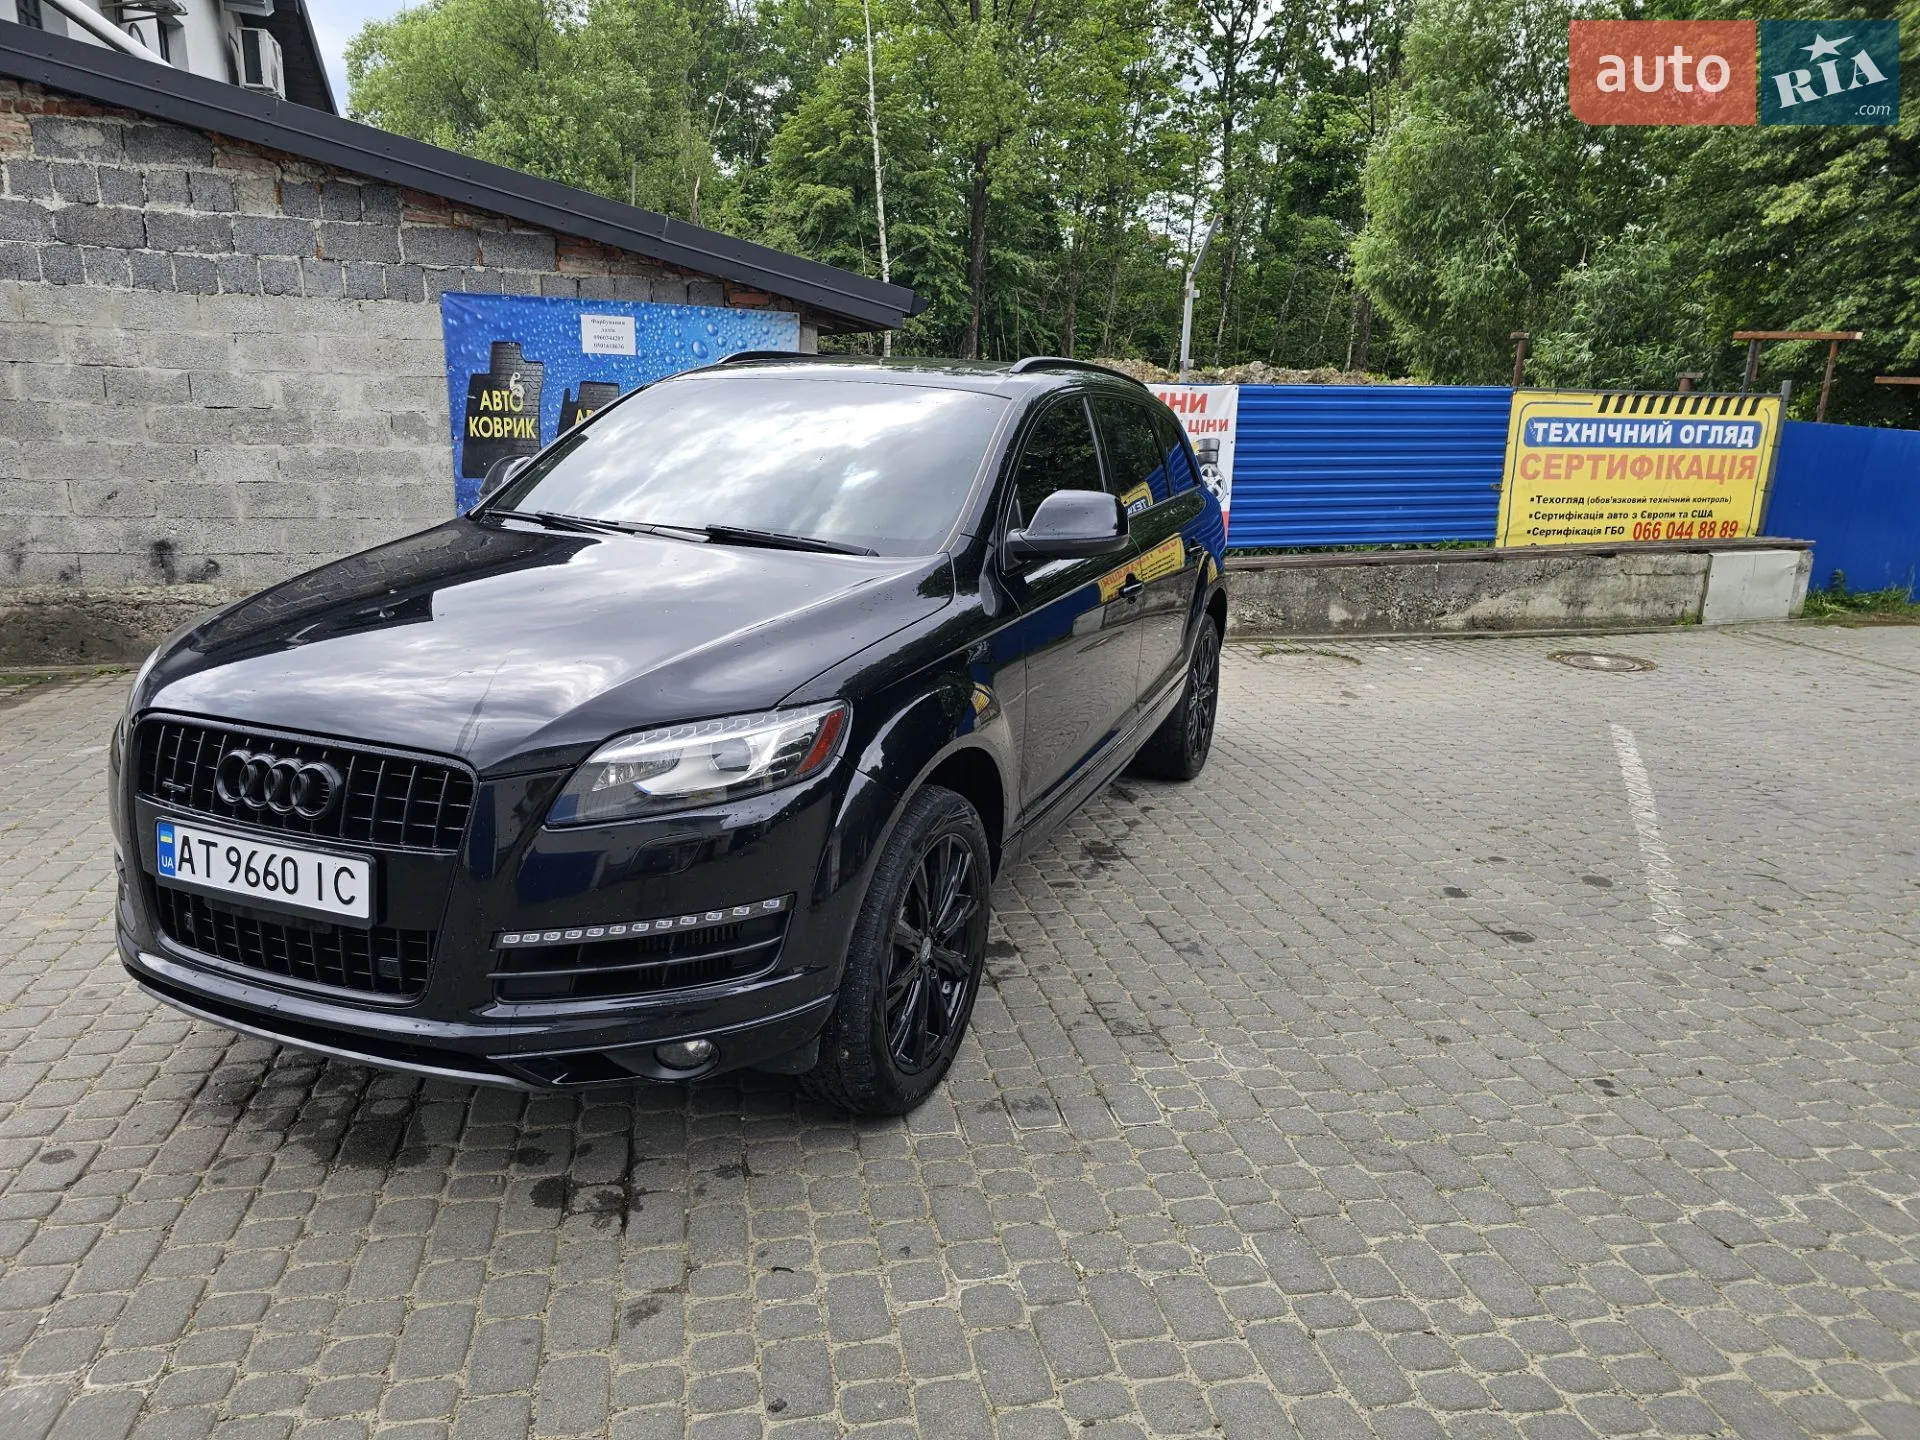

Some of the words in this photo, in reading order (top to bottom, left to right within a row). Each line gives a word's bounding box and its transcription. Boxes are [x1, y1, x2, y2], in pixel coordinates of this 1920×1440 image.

[479, 389, 523, 412] АВТО
[468, 416, 537, 439] КОВРИК
[1188, 419, 1229, 435] ЦІНИ
[1534, 421, 1672, 444] ТЕХНІЧНИЙ
[1679, 424, 1754, 448] ОГЛЯД
[1519, 453, 1758, 485] СЕРТИФІКАЦІЯ
[1535, 495, 1585, 505] Техогляд
[1650, 495, 1690, 504] технічний
[1692, 496, 1732, 505] контроль)
[1534, 511, 1604, 521] Сертифікація
[1640, 510, 1676, 520] Європи
[1691, 509, 1713, 518] США
[1532, 527, 1602, 538] Сертифікація
[1604, 526, 1625, 535] ГБО
[1633, 521, 1662, 541] 066
[1666, 520, 1695, 539] 044
[1698, 520, 1717, 538] 88
[1719, 519, 1739, 538] 89
[161, 855, 175, 869] UA
[177, 835, 218, 878] AT
[225, 845, 298, 895] 9660
[317, 862, 356, 905] IC
